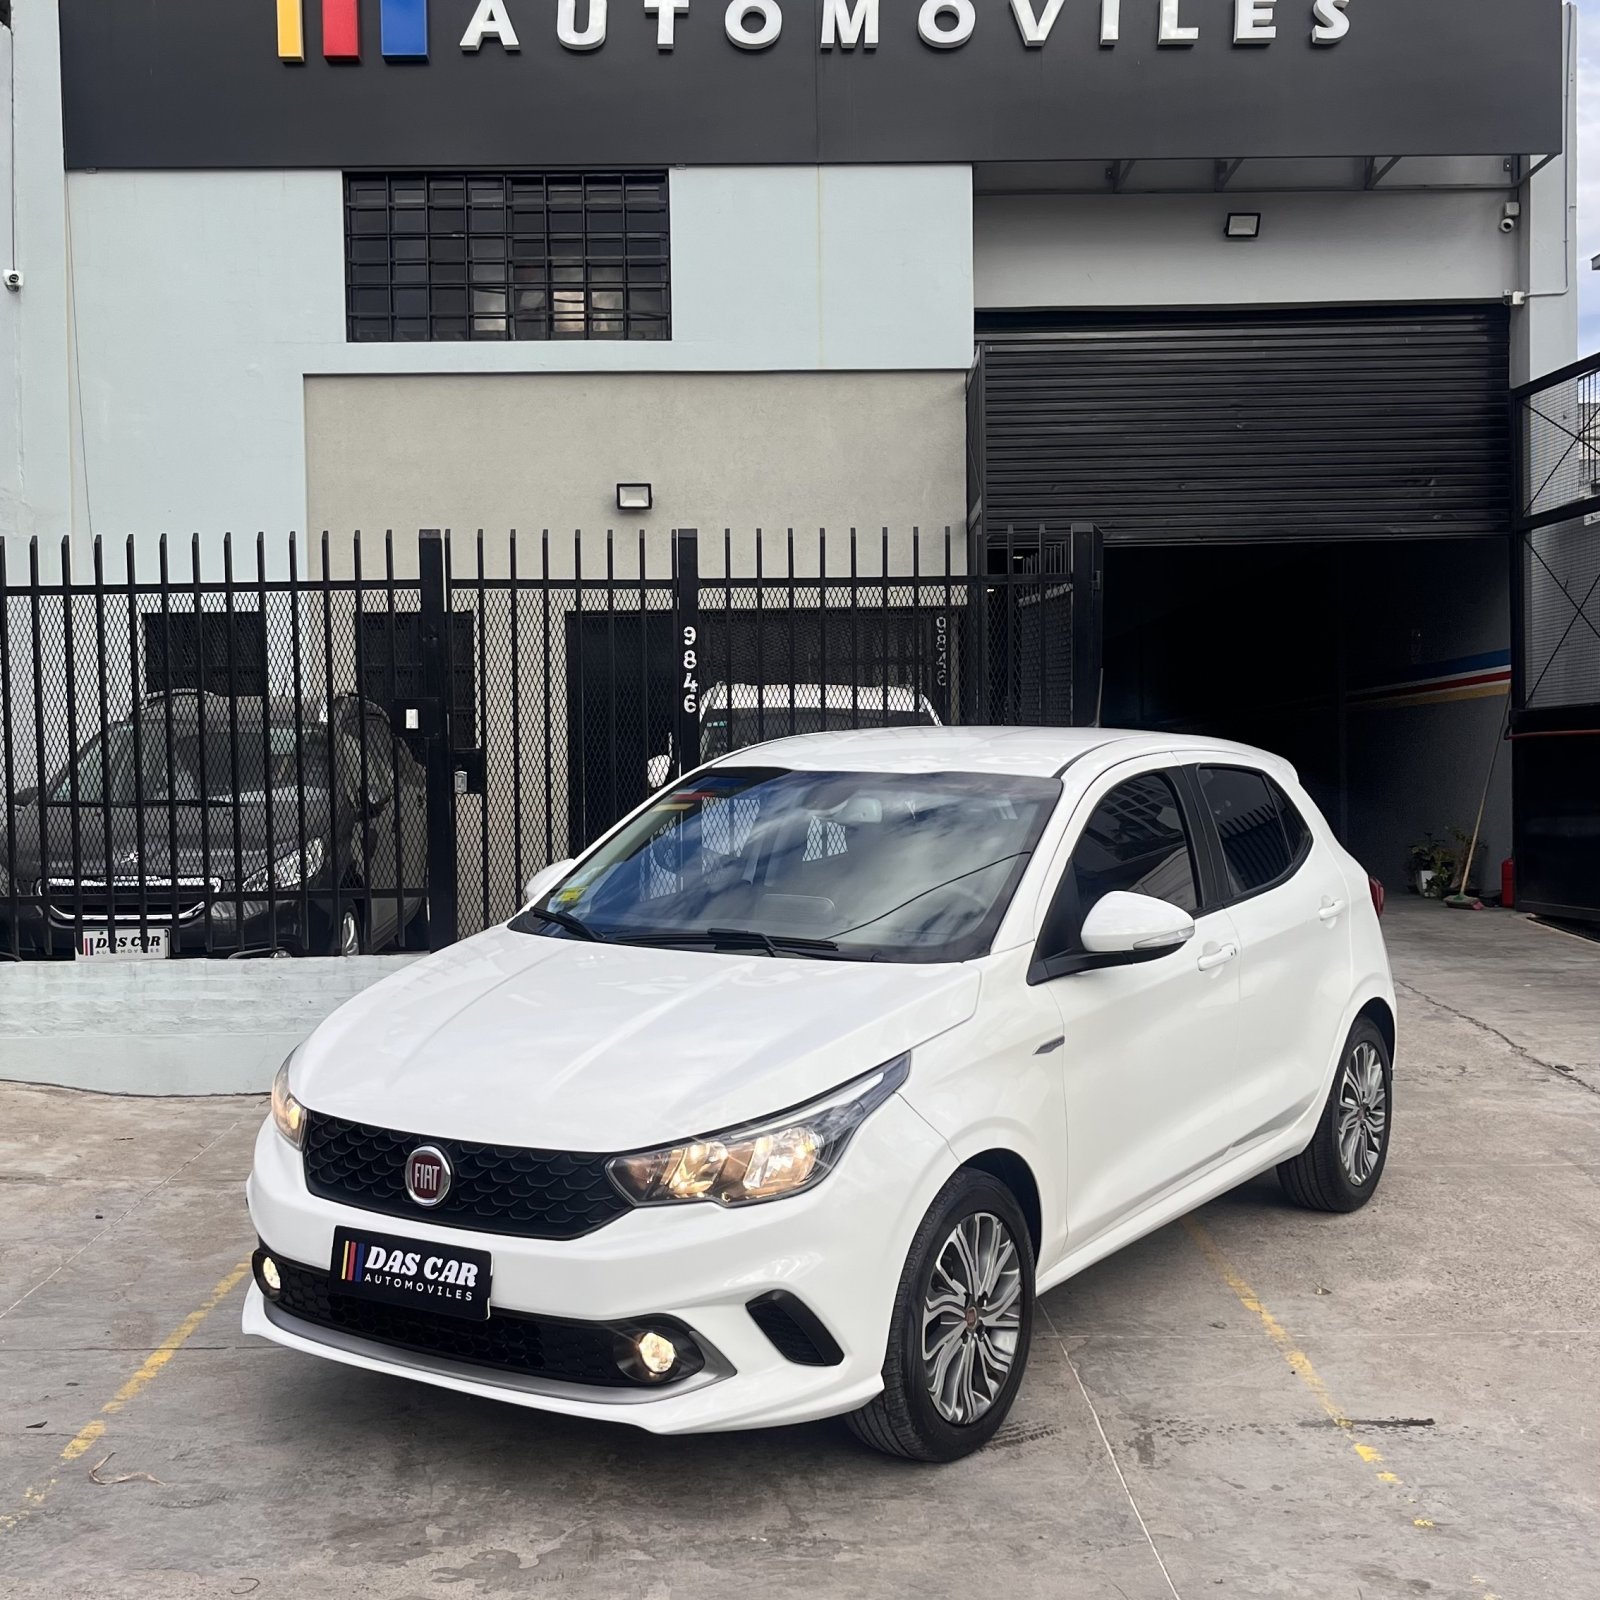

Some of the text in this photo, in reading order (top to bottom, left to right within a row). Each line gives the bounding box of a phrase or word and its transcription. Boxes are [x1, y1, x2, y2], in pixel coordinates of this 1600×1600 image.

[459, 0, 1351, 50] AUTOMOVILES
[683, 626, 698, 713] 9846
[96, 936, 161, 948] DS CR
[414, 1163, 440, 1190] FIAT
[365, 1246, 478, 1287] DAS CAR
[364, 1273, 473, 1301] AUTOMOVILES
